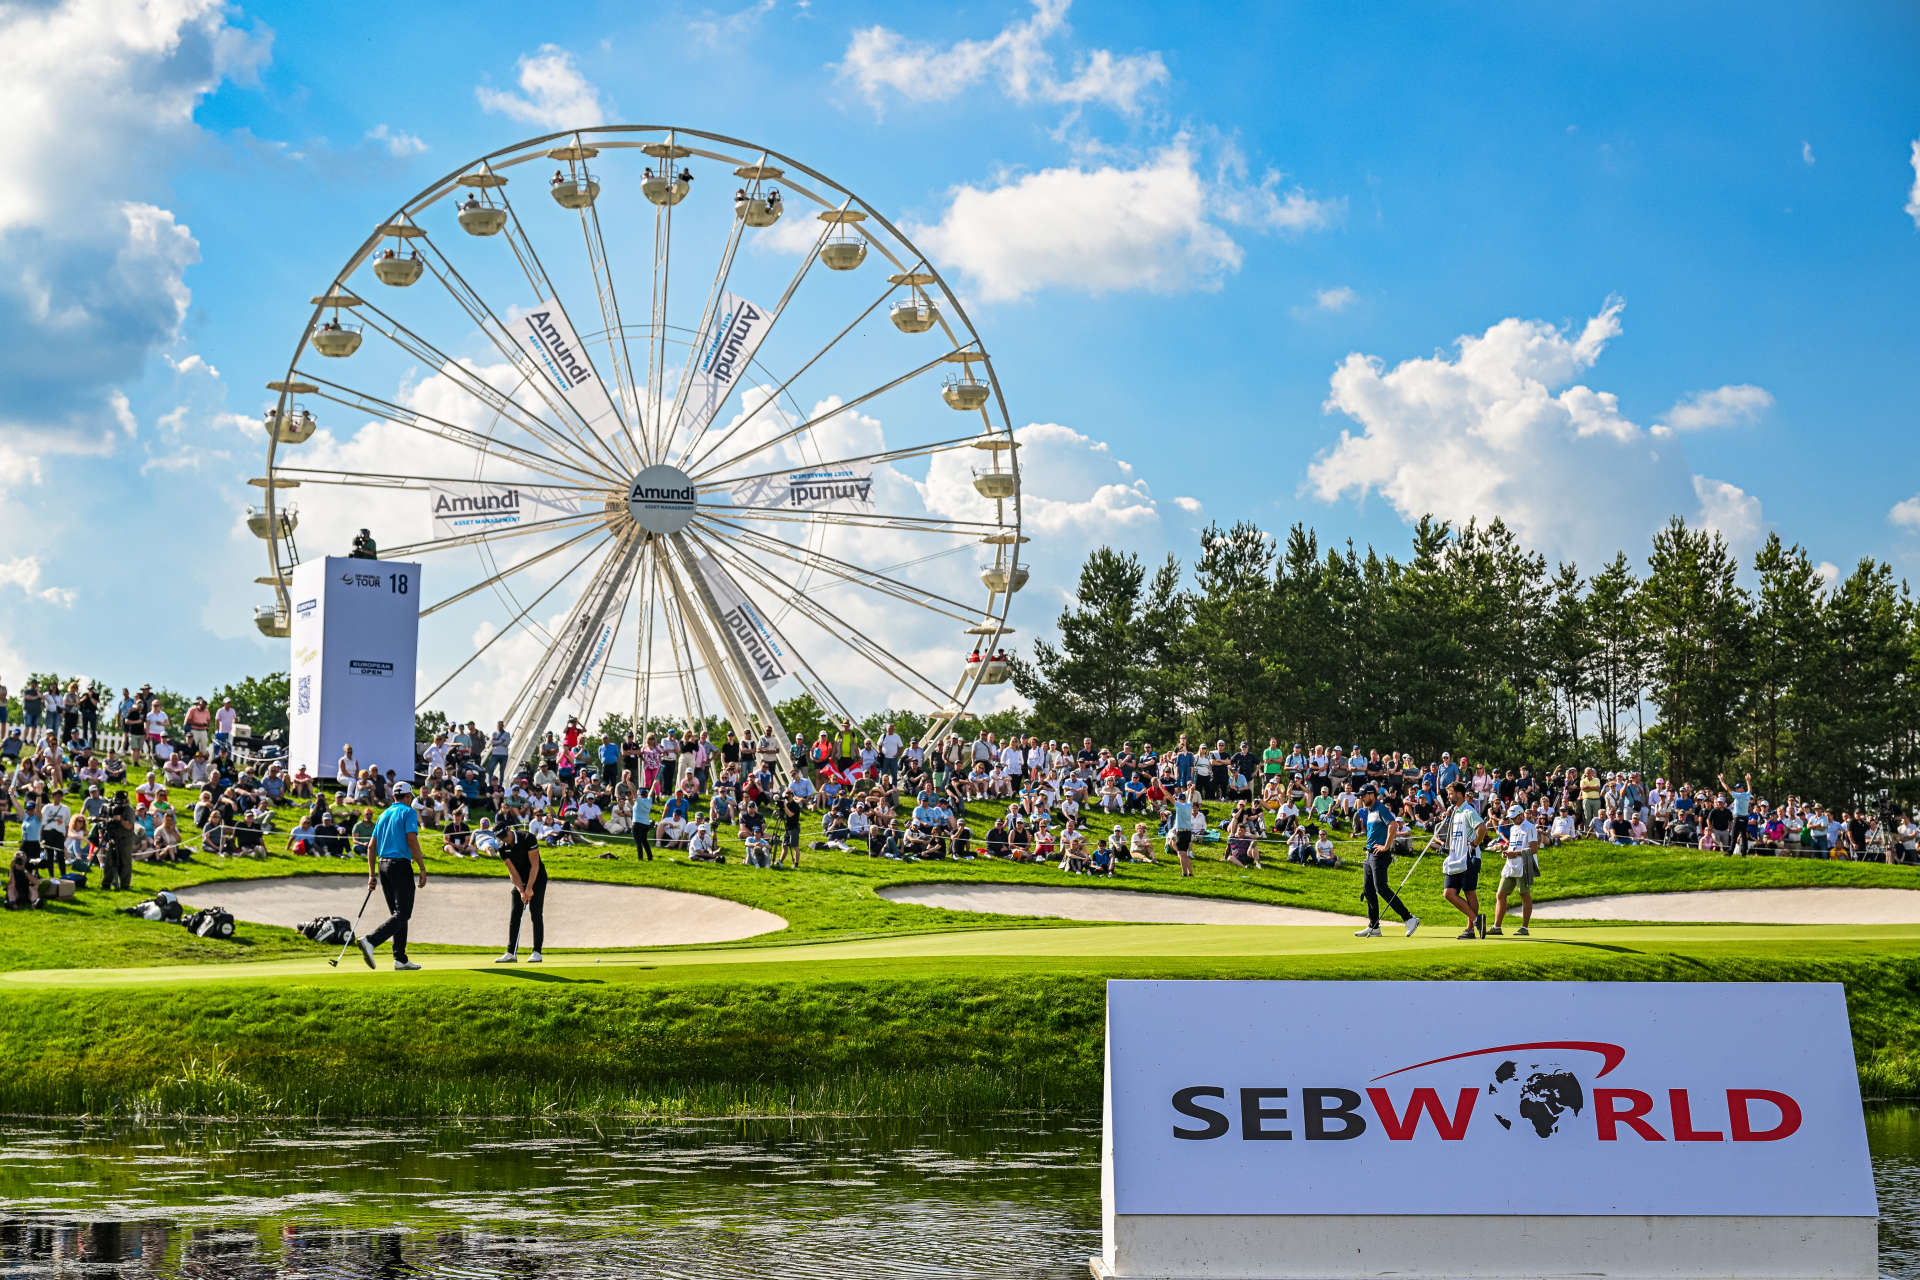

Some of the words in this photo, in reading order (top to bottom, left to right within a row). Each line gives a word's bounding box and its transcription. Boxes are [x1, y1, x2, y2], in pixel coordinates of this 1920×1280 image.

[720, 312, 732, 331] ASSET
[531, 311, 591, 385] Amundi
[714, 303, 760, 384] Amundi
[528, 335, 543, 352] ASSET
[541, 353, 569, 392] MANAGEMENT
[434, 489, 520, 513] Amundi
[631, 484, 694, 500] Amundi
[790, 483, 871, 506] Amundi
[356, 578, 381, 588] TOUR
[389, 573, 408, 594] 18
[724, 608, 782, 681] Amundi
